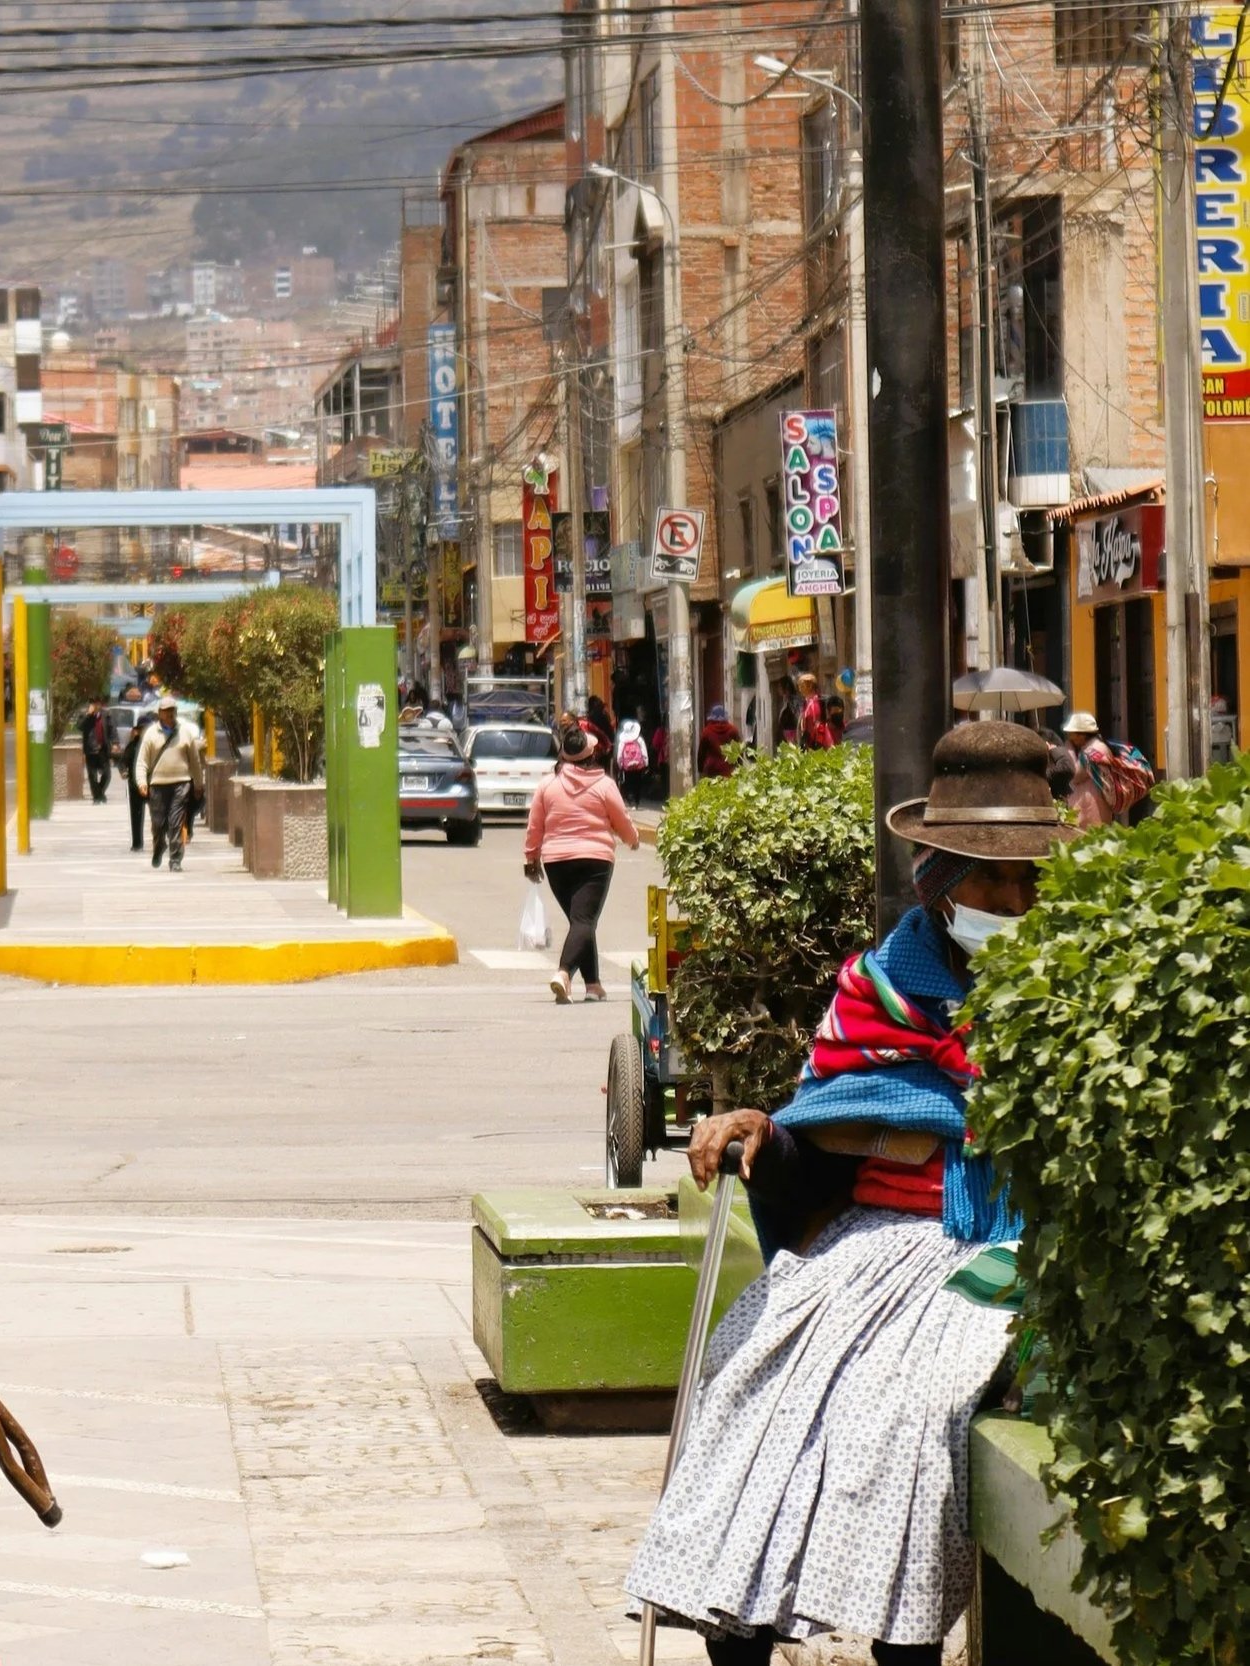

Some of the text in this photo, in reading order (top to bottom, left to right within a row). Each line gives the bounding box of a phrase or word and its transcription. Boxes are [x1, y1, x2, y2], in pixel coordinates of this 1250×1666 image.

[1190, 15, 1245, 364] LIBRERIA
[434, 329, 457, 503] HOTEL
[783, 413, 815, 565] SALON
[813, 464, 842, 551] SPA
[796, 583, 840, 593] ANGHEL
[797, 569, 838, 581] JOYERIA
